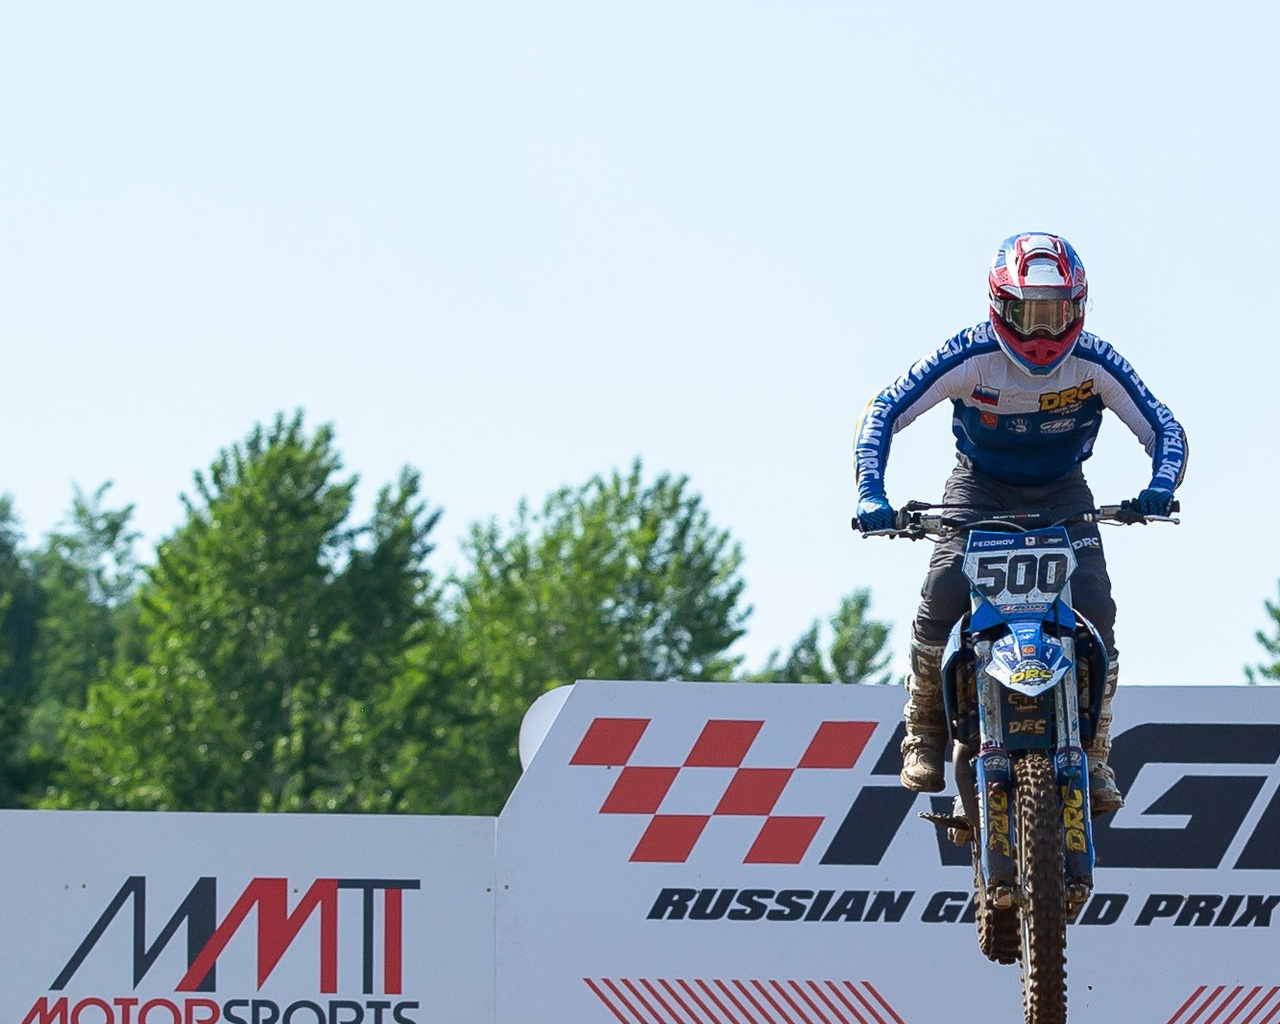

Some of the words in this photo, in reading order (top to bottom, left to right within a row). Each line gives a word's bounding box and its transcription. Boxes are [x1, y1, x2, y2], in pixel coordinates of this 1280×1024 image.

[1039, 379, 1094, 411] DRC
[1072, 537, 1100, 550] DRC
[975, 554, 1068, 597] 500
[1010, 669, 1054, 685] DRC
[1061, 785, 1087, 853] DRC
[646, 887, 915, 923] RUSSIAN
